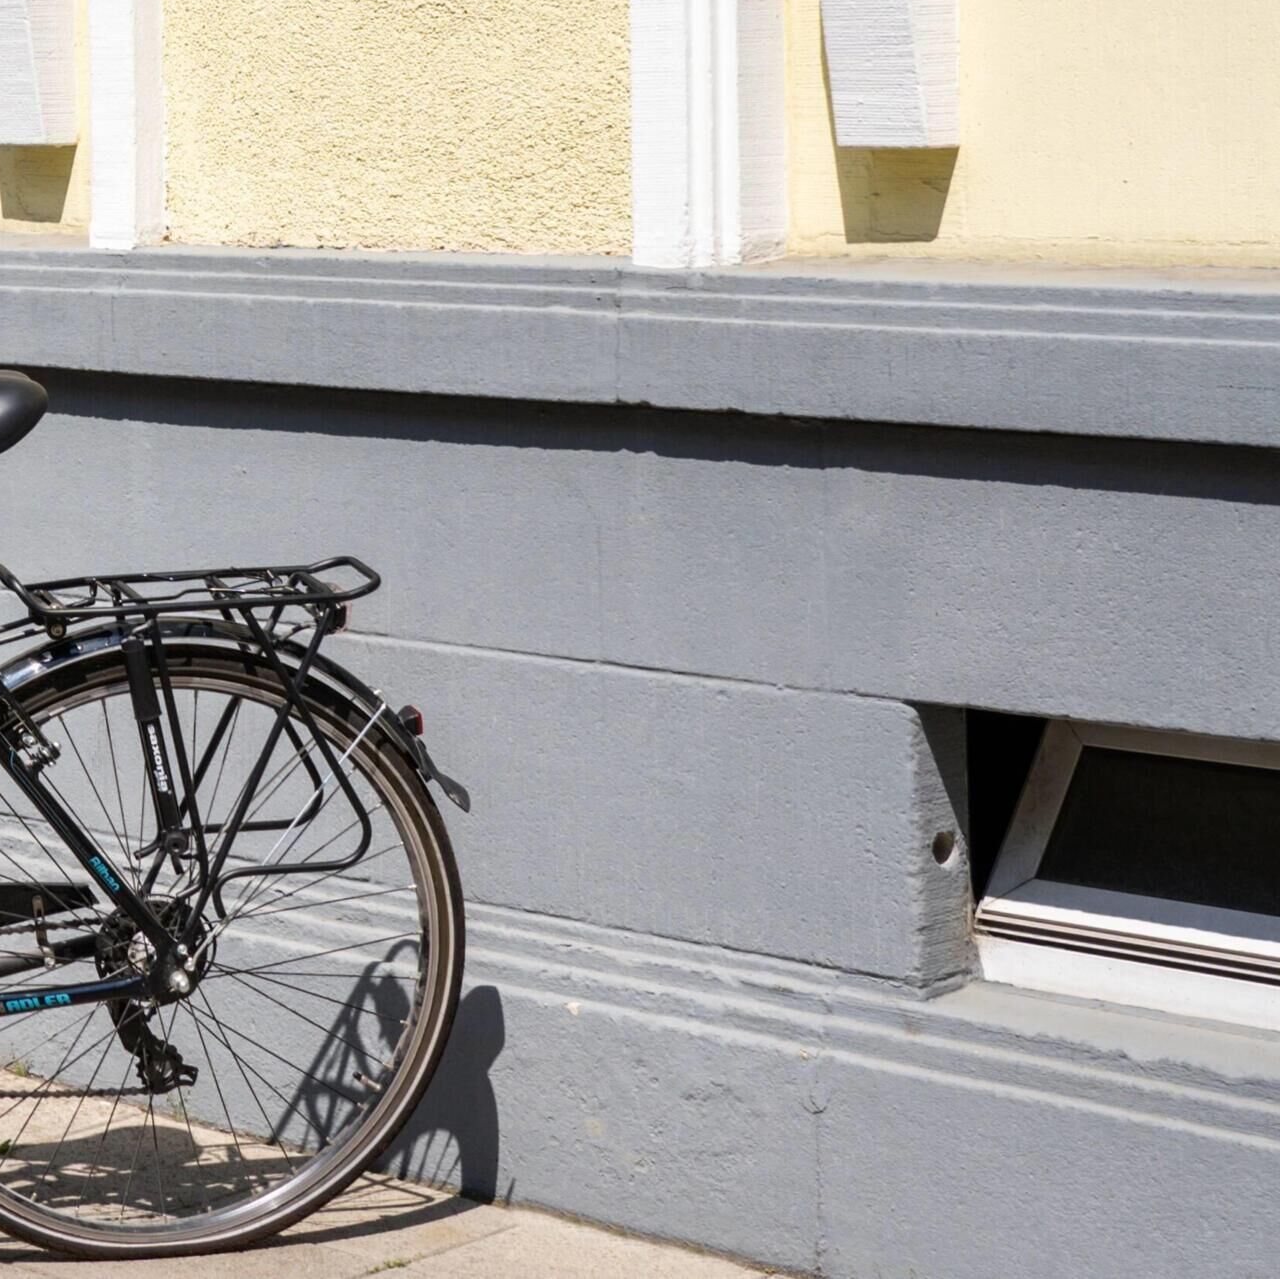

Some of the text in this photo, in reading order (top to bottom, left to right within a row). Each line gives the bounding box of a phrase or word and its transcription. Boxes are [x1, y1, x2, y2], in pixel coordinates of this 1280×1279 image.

[146, 723, 169, 794] saxonia
[89, 855, 121, 892] Rilhan
[5, 992, 71, 1012] ADLER
